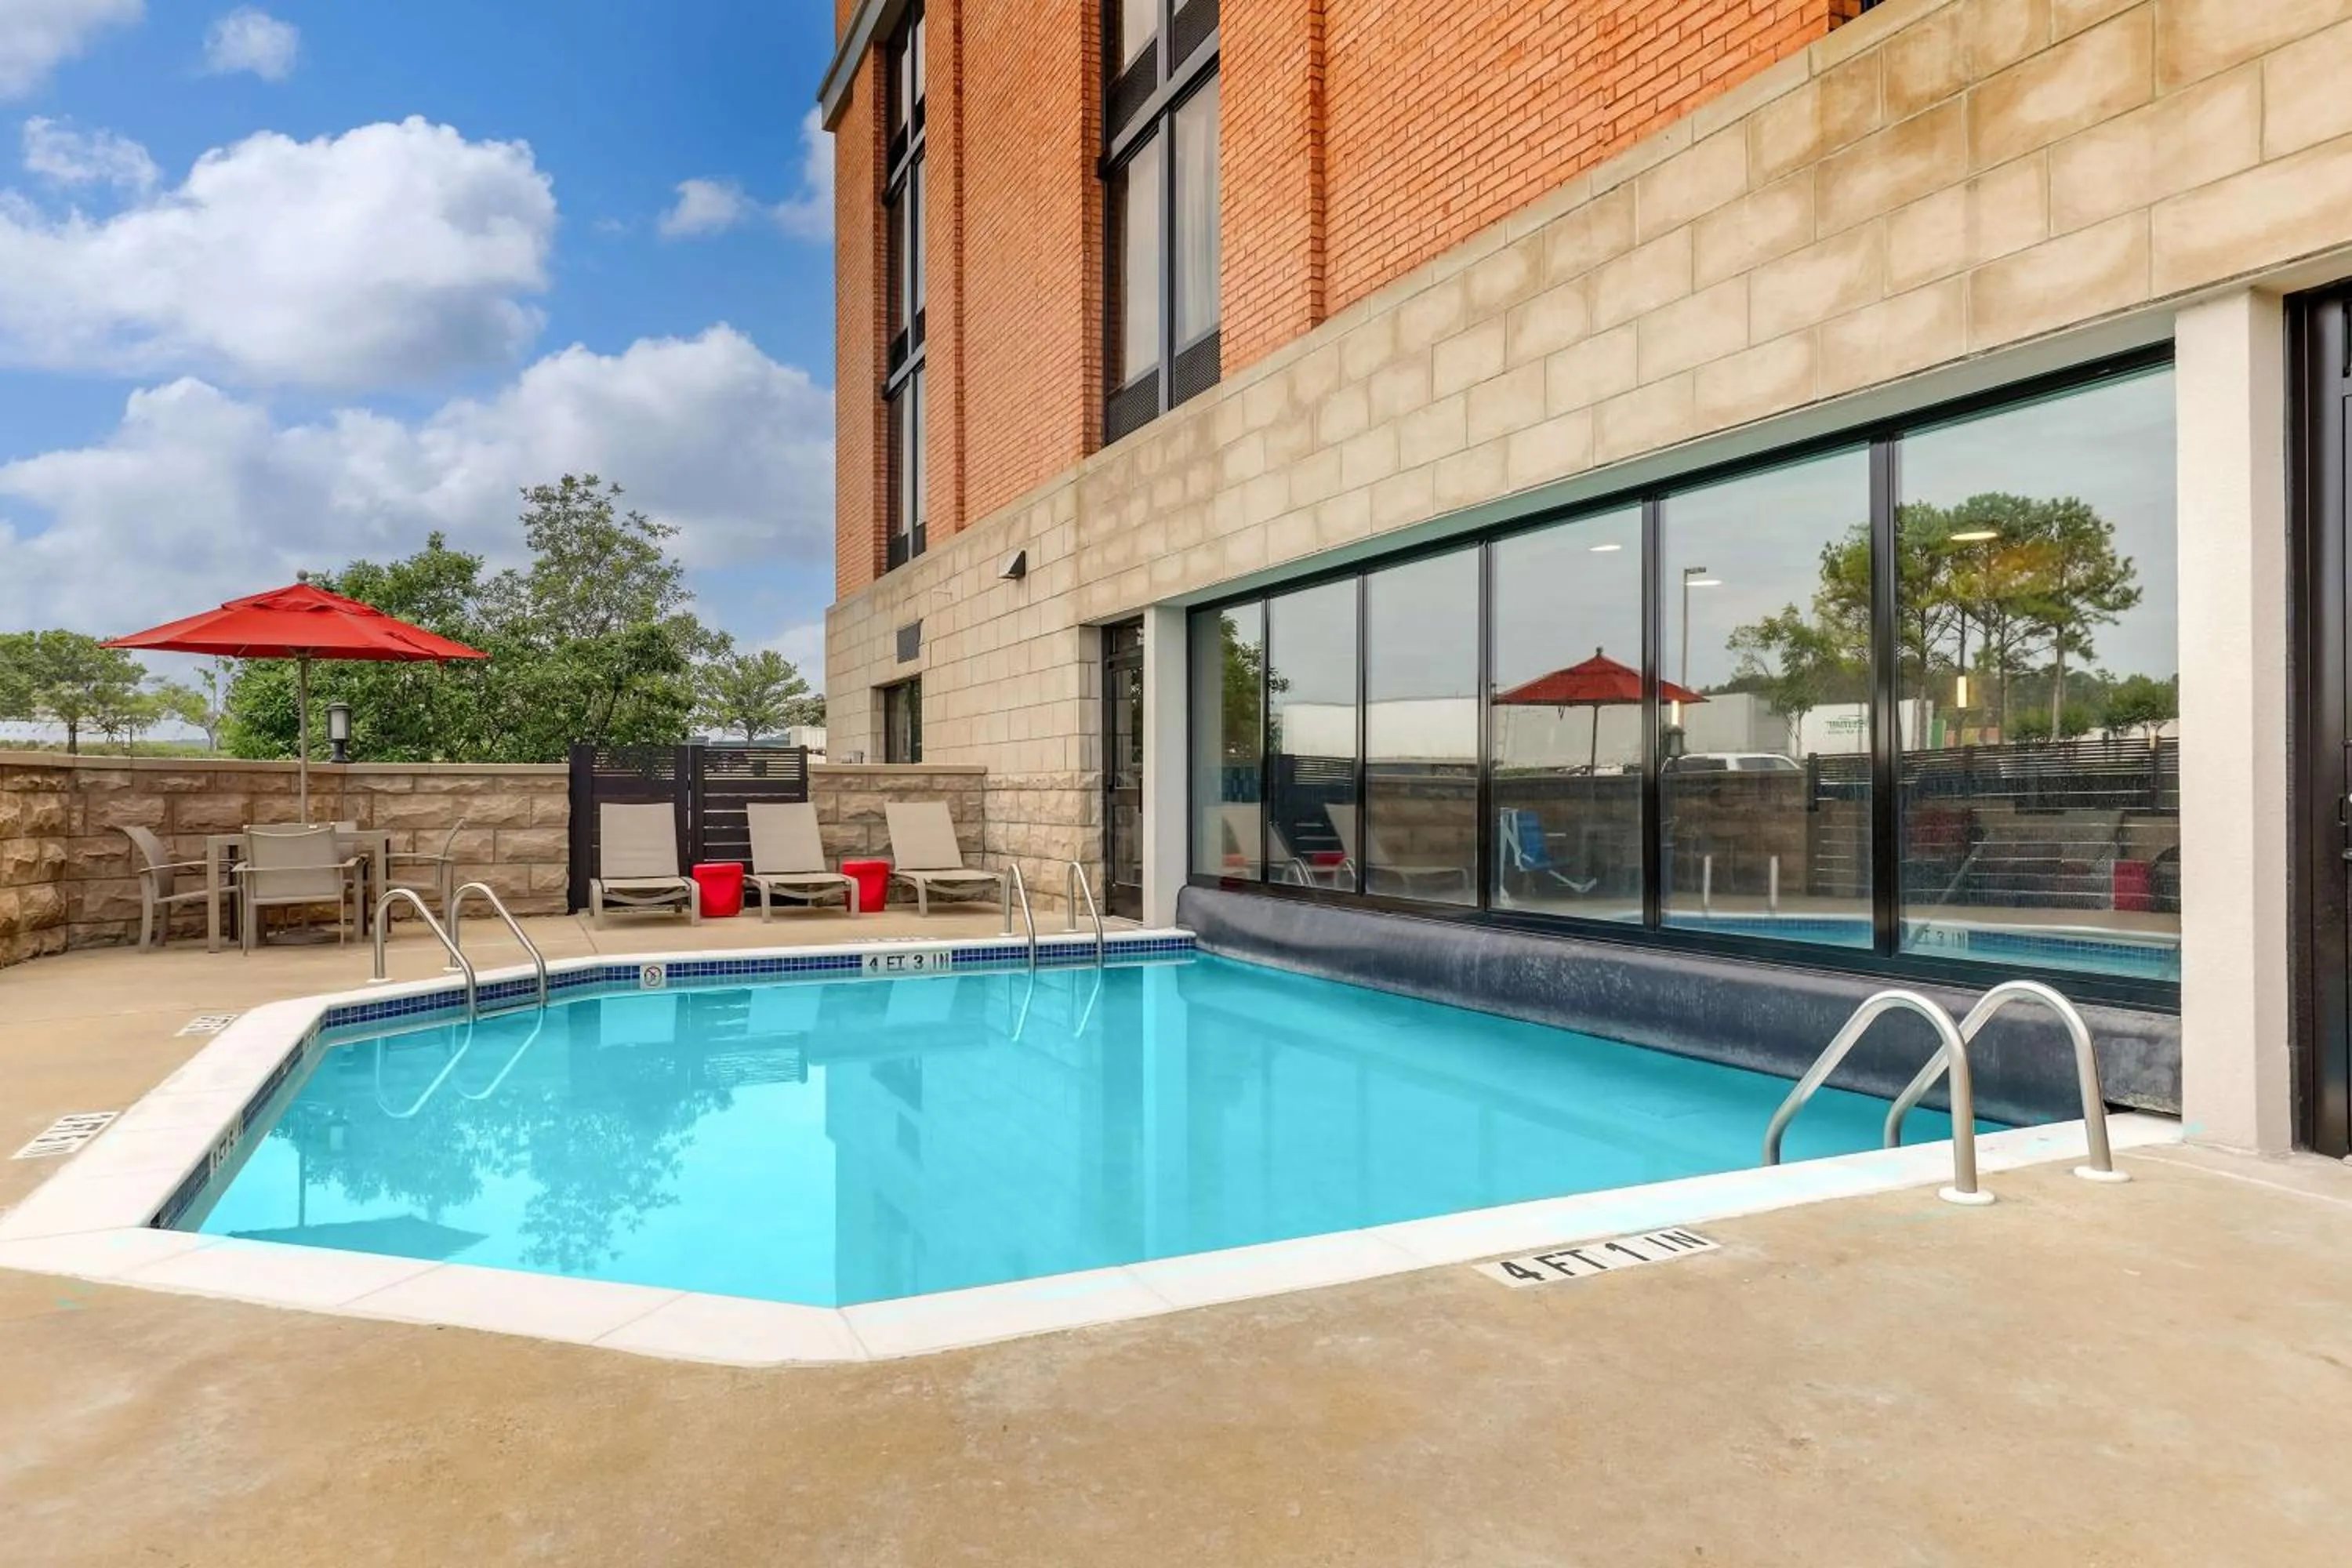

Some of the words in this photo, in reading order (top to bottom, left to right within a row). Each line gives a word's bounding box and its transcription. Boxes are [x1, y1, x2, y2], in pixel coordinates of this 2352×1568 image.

[913, 954, 924, 970] 3
[1501, 1261, 1545, 1281] 4
[1533, 1249, 1608, 1276] FT
[1605, 1242, 1651, 1261] 1
[1643, 1230, 1708, 1251] IN
